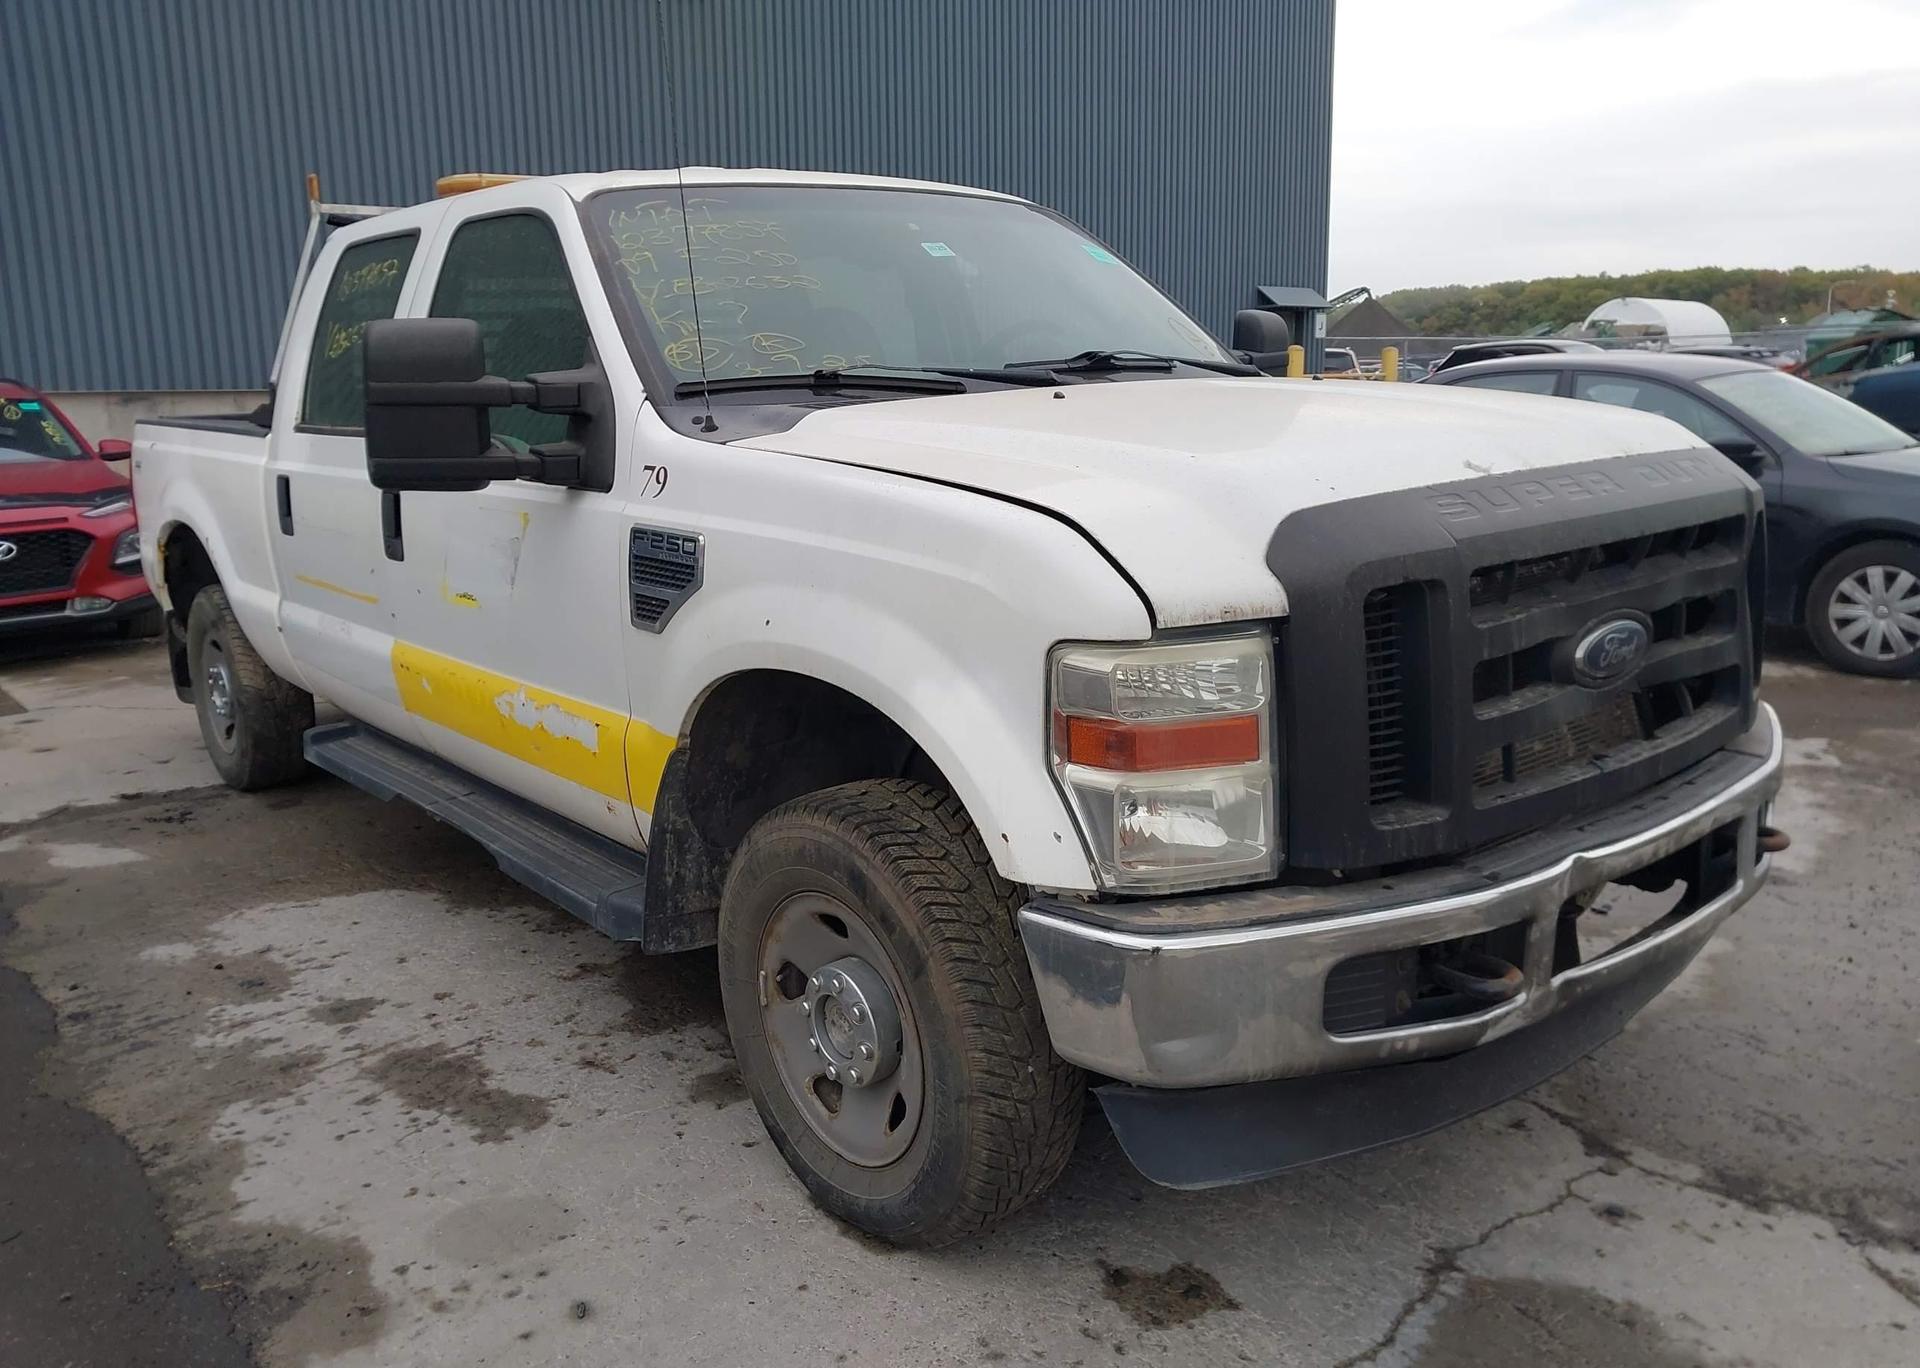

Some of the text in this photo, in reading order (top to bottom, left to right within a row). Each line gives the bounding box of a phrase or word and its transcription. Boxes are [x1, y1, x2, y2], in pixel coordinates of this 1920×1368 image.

[640, 464, 669, 499] 79
[1426, 470, 1626, 522] SUPER
[1600, 631, 1638, 668] Ford
